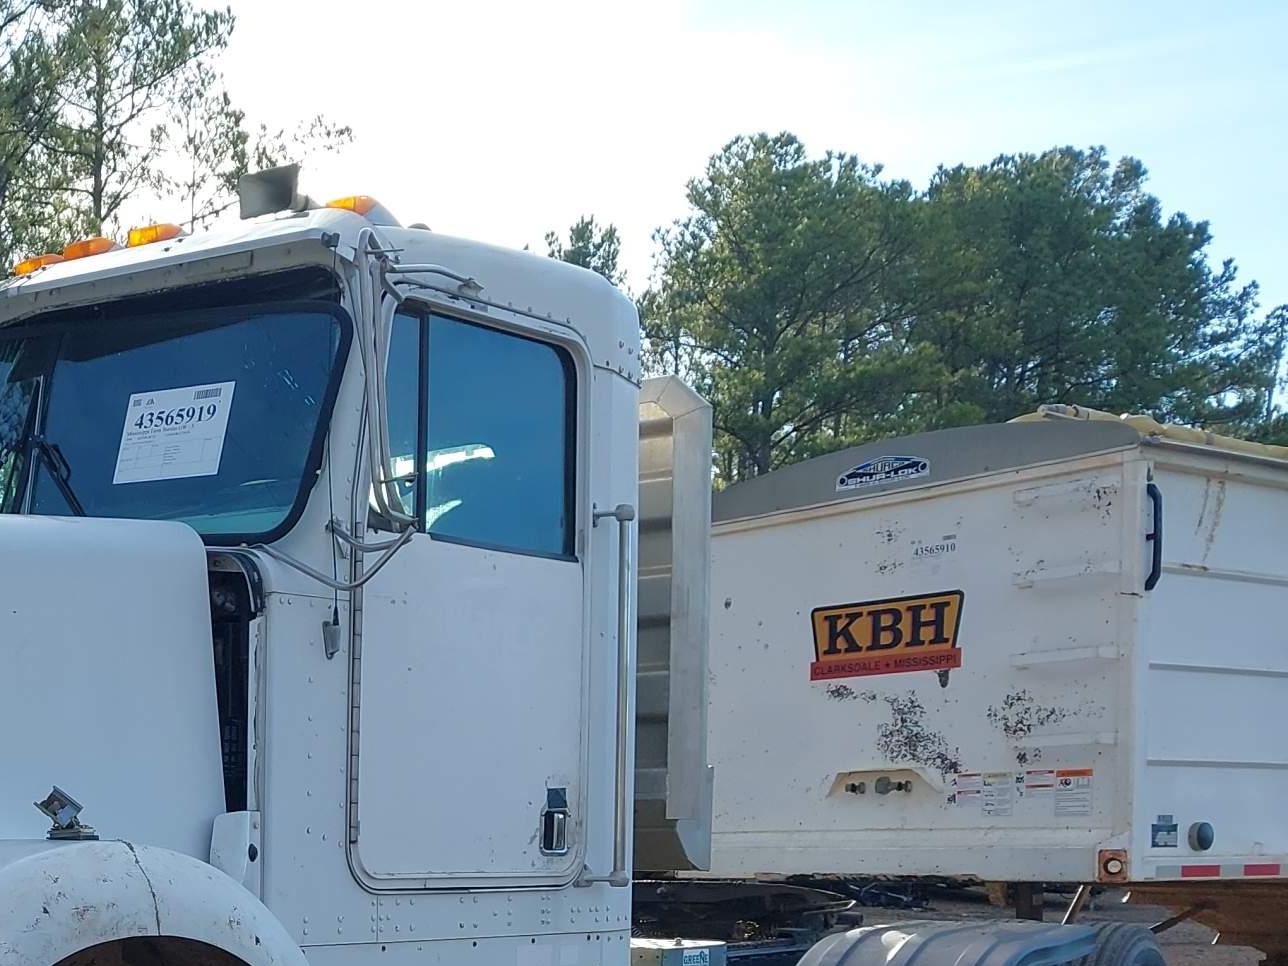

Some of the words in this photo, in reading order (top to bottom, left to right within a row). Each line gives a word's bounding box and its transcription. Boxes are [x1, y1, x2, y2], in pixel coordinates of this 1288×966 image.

[134, 403, 217, 429] 43565919
[847, 466, 919, 485] SHUR-LOK
[913, 543, 956, 556] 43565910
[823, 601, 951, 655] KBH
[814, 660, 881, 676] CLARKSDALE
[894, 654, 957, 669] MISSISSIPPI
